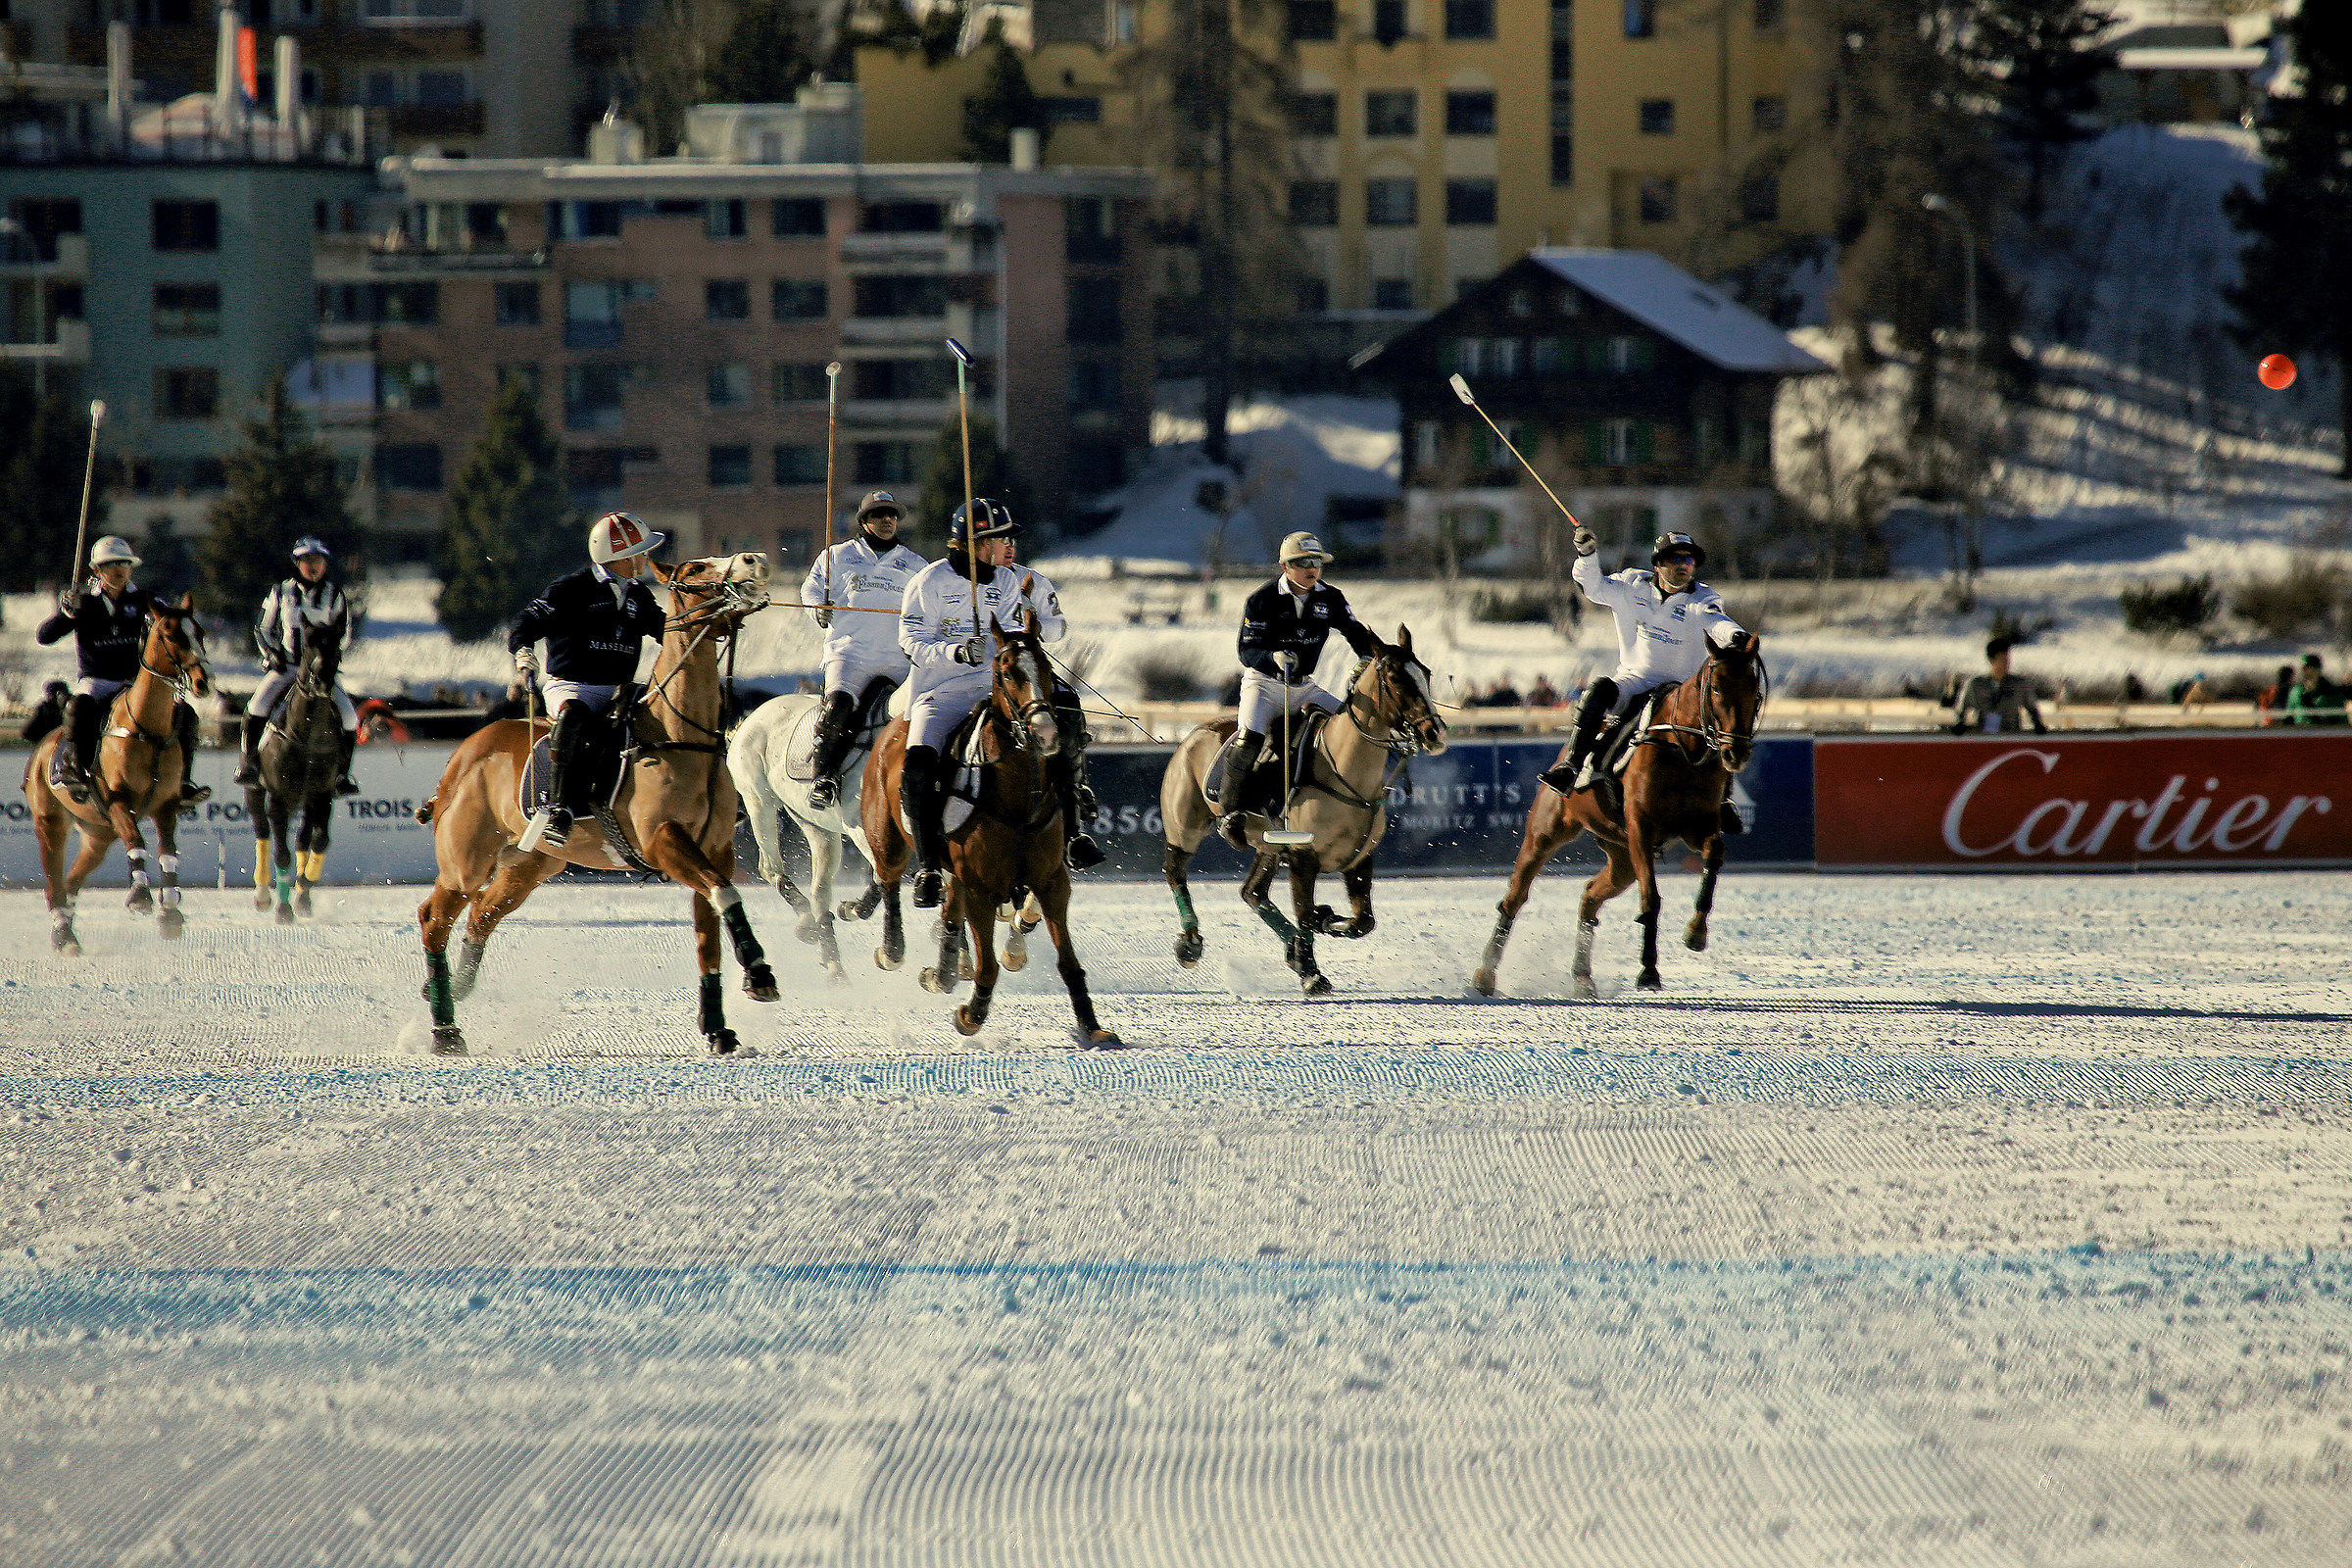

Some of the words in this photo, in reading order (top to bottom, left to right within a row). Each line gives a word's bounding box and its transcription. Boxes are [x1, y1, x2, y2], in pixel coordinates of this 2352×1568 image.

[1012, 602, 1025, 628] 4
[346, 799, 414, 819] TROIS
[1941, 748, 2332, 858] Cartier
[1079, 804, 1163, 834] 856
